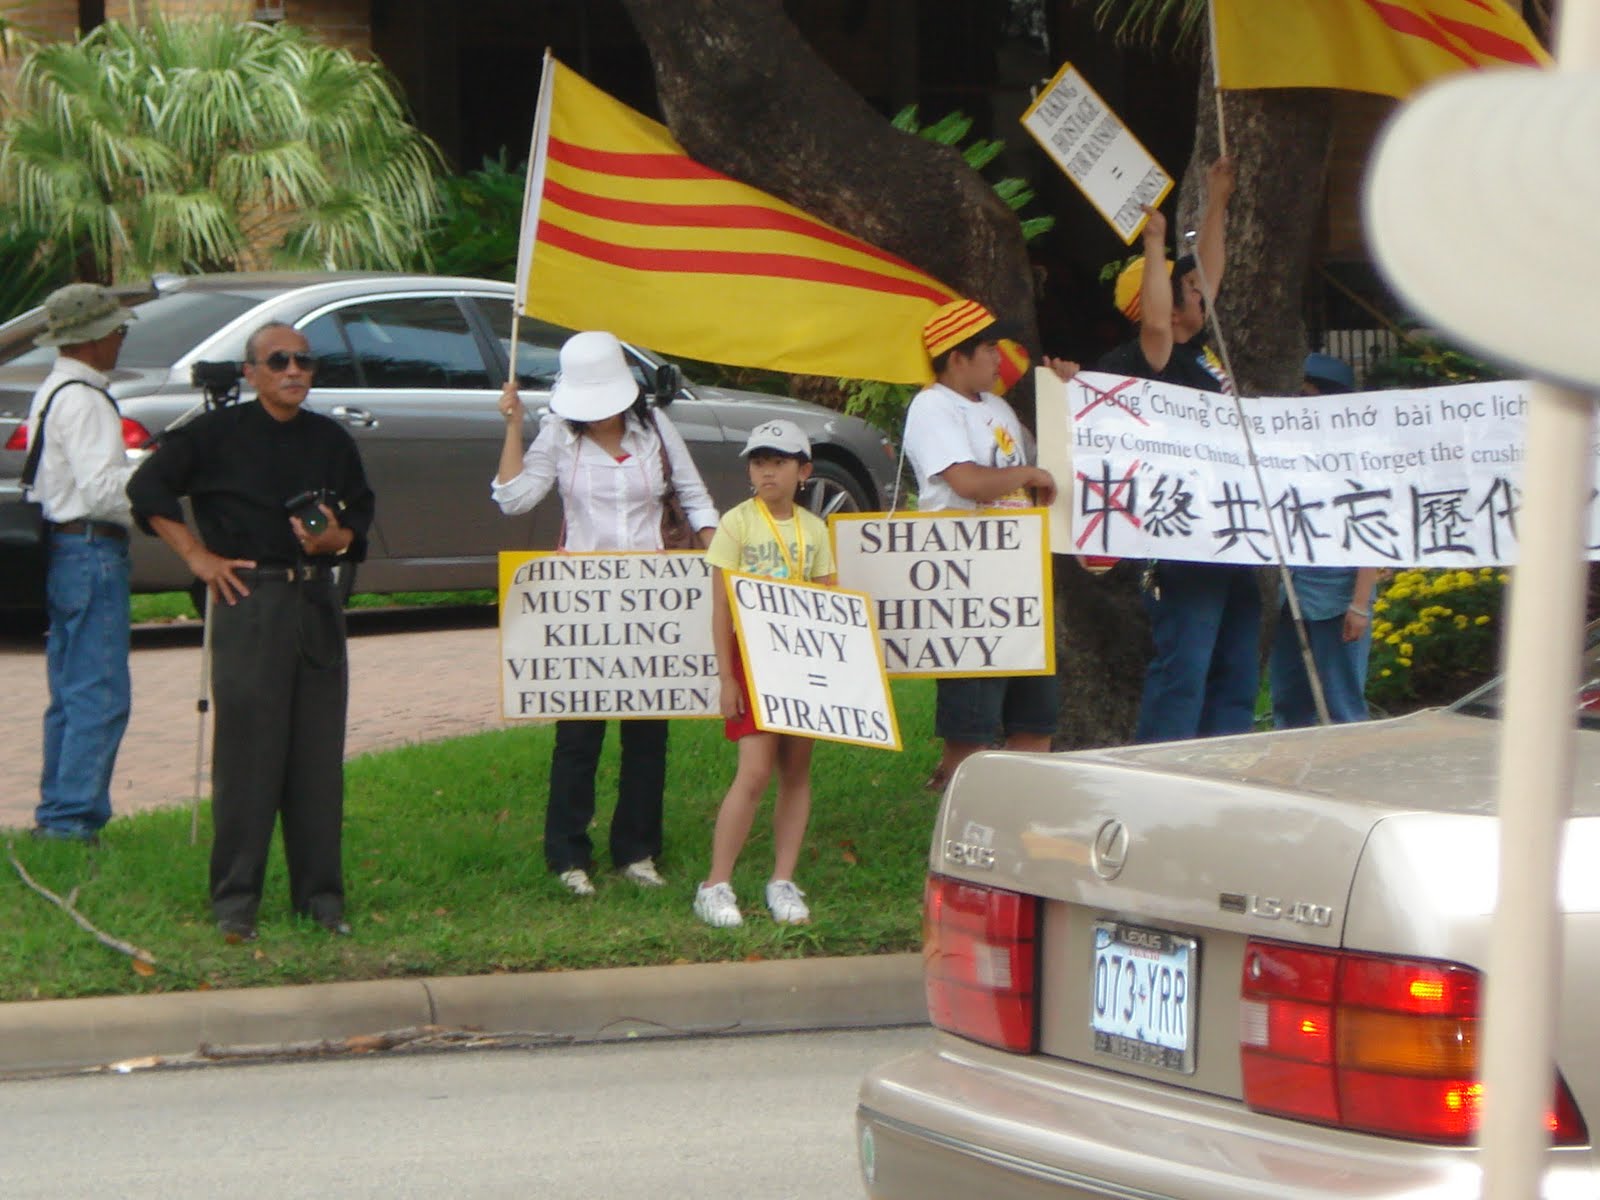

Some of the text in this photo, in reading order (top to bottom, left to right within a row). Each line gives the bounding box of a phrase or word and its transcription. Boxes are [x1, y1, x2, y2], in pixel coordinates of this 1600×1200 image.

[1331, 407, 1378, 430] nhớ
[1394, 405, 1432, 428] bài
[1440, 399, 1487, 423] học
[1076, 427, 1116, 455] Hey
[1120, 432, 1191, 459] Commie
[1258, 455, 1297, 471] etter
[1302, 452, 1355, 473] NOT
[1360, 450, 1427, 474] forget
[1430, 442, 1464, 462] the
[860, 519, 1021, 554] SHAME
[514, 557, 713, 585] CHINESE NAVY
[909, 559, 973, 591] ON
[521, 587, 702, 614] MUST STOP
[735, 578, 868, 629] CHINESE
[877, 596, 1041, 630] HINESE
[544, 621, 681, 647] KILLING
[767, 622, 848, 664] NAVY
[507, 654, 720, 681] VIETNAMESE
[883, 635, 1002, 670] NAVY
[518, 687, 710, 715] FISHERMEN
[761, 693, 889, 742] PIRATES
